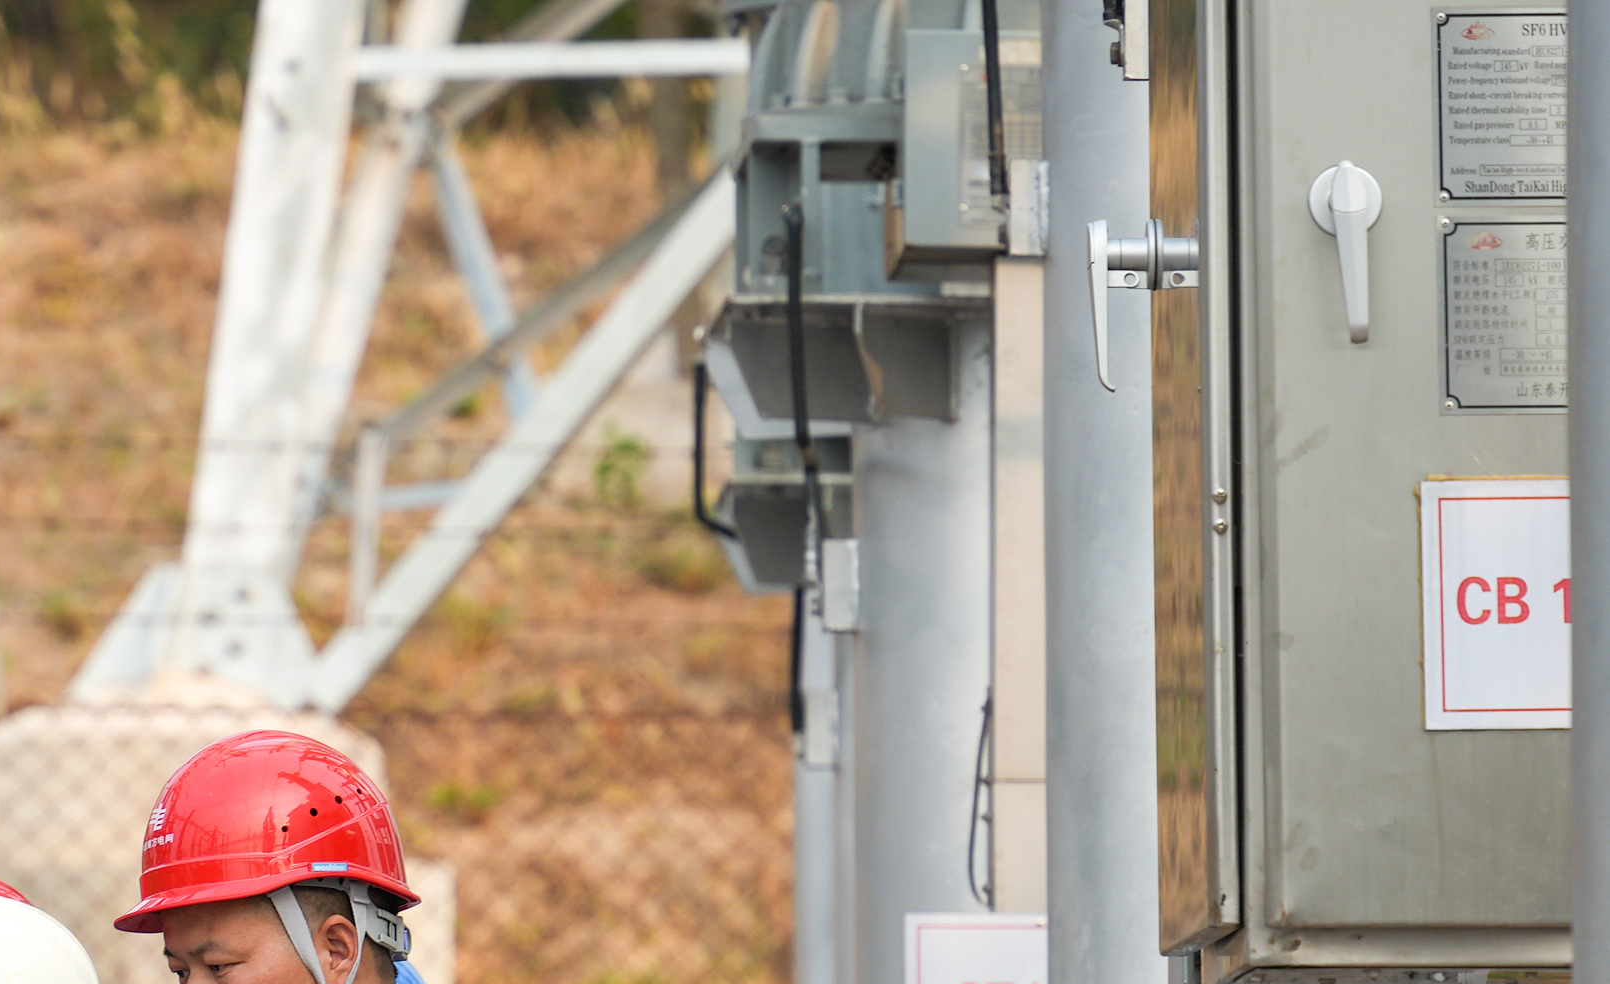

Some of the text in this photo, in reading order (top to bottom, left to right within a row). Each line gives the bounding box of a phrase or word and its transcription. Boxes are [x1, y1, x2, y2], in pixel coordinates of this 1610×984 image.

[1521, 23, 1546, 37] SF6
[1501, 46, 1531, 56] standard
[1448, 61, 1468, 70] Rated
[1469, 61, 1492, 71] voltage
[1534, 60, 1553, 70] Rated
[1448, 91, 1468, 100] Rated
[1513, 91, 1542, 101] breaking
[1448, 106, 1470, 115] Rated
[1471, 105, 1500, 115] thermal
[1500, 105, 1530, 115] stability
[1531, 105, 1548, 114] time
[1454, 121, 1473, 130] Rated
[1474, 122, 1485, 131] gas
[1486, 122, 1515, 131] pressure
[1449, 136, 1492, 146] Temperature
[1493, 136, 1510, 144] class
[1451, 166, 1477, 175] Address
[1465, 180, 1516, 195] ShanDong
[1516, 180, 1550, 193] TaiKai
[1525, 233, 1569, 251] 高压交
[1516, 381, 1569, 398] 山东泰开
[1457, 576, 1531, 625] CB
